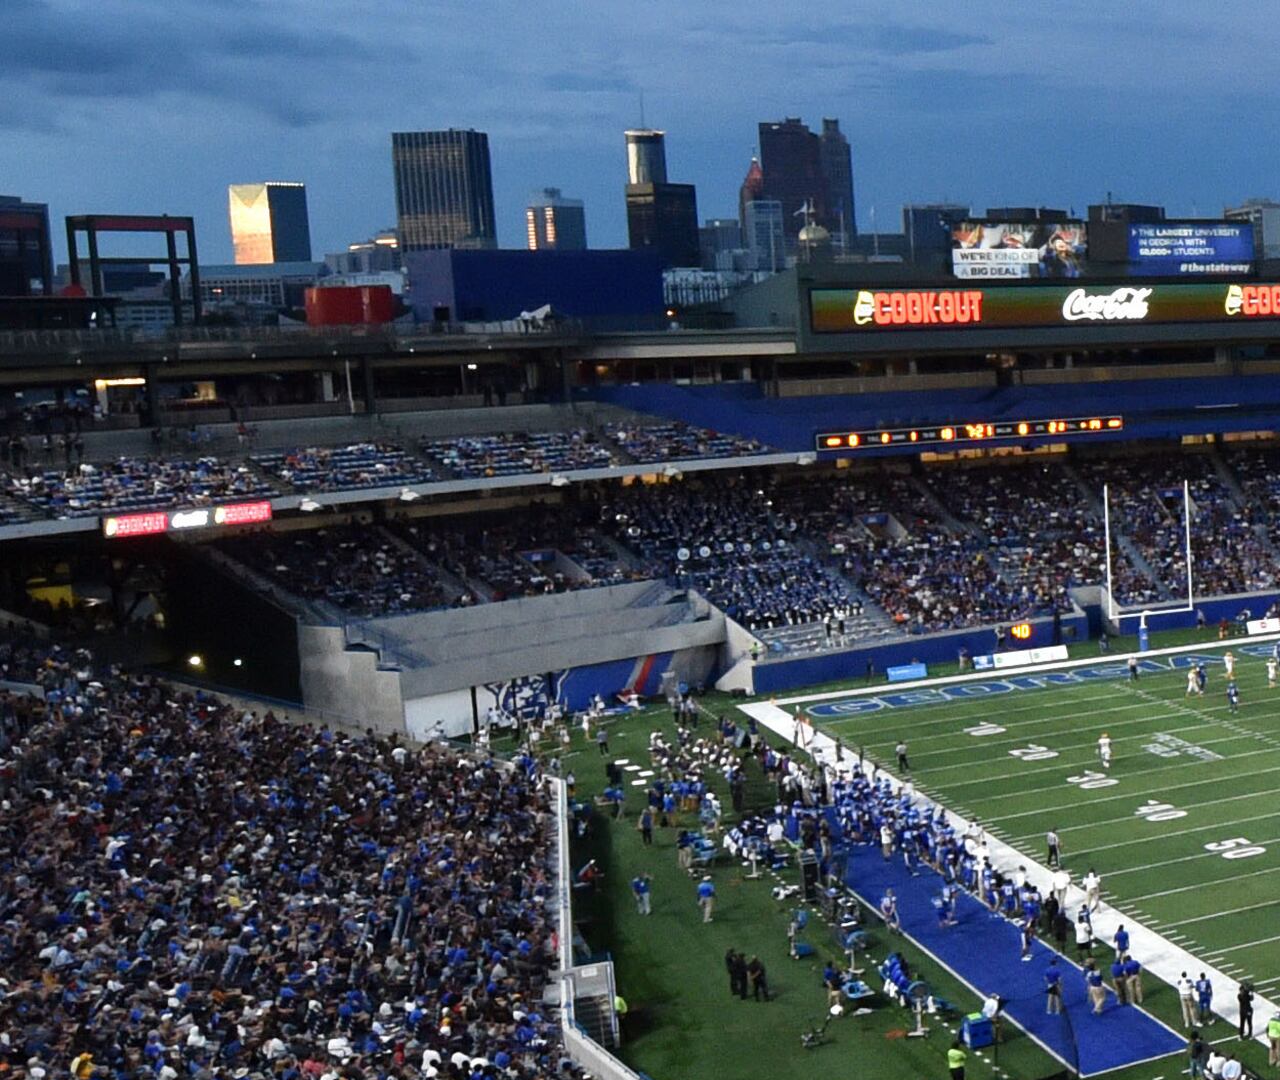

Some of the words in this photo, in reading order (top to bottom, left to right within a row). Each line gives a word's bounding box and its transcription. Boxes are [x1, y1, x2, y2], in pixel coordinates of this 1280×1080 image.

[1139, 229, 1154, 237] THE
[1156, 229, 1193, 237] LARGEST
[1195, 229, 1240, 237] UNIVERSITY
[1139, 238, 1147, 246] IN
[1149, 238, 1184, 246] GEORGIA
[1186, 238, 1206, 246] WITH
[960, 252, 993, 261] WE'RE
[1174, 247, 1215, 255] STUDENTS
[970, 267, 988, 276] BIG
[990, 267, 1018, 276] DEAL
[1180, 263, 1249, 273] #thestateway
[874, 291, 984, 325] COOK-OUT
[1063, 287, 1153, 321] Coca-Cola
[1012, 623, 1031, 639] 40
[1066, 772, 1120, 789] 30
[1134, 803, 1189, 822] 40
[1203, 837, 1267, 860] 50
